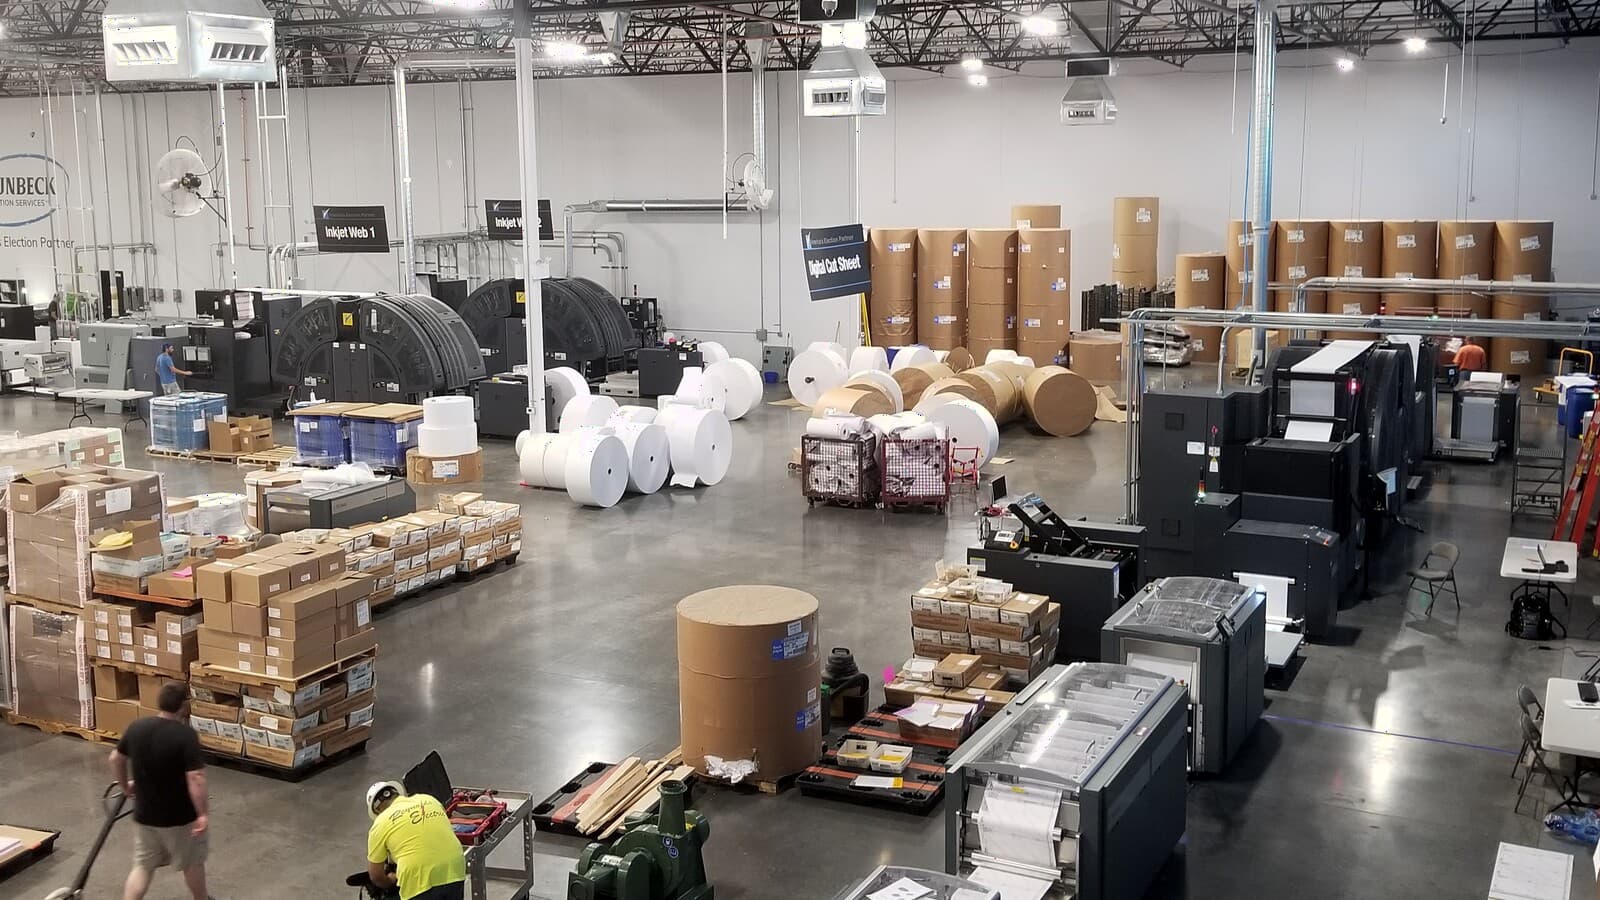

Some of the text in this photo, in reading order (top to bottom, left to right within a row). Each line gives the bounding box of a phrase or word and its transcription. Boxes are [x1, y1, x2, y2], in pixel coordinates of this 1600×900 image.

[16, 199, 45, 207] SERVICES
[495, 217, 516, 229] Inkjet
[325, 226, 375, 240] Inkjet Web 1
[3, 236, 38, 247] Election
[40, 237, 75, 248] Partner
[808, 254, 861, 278] Digital Cut Sheet
